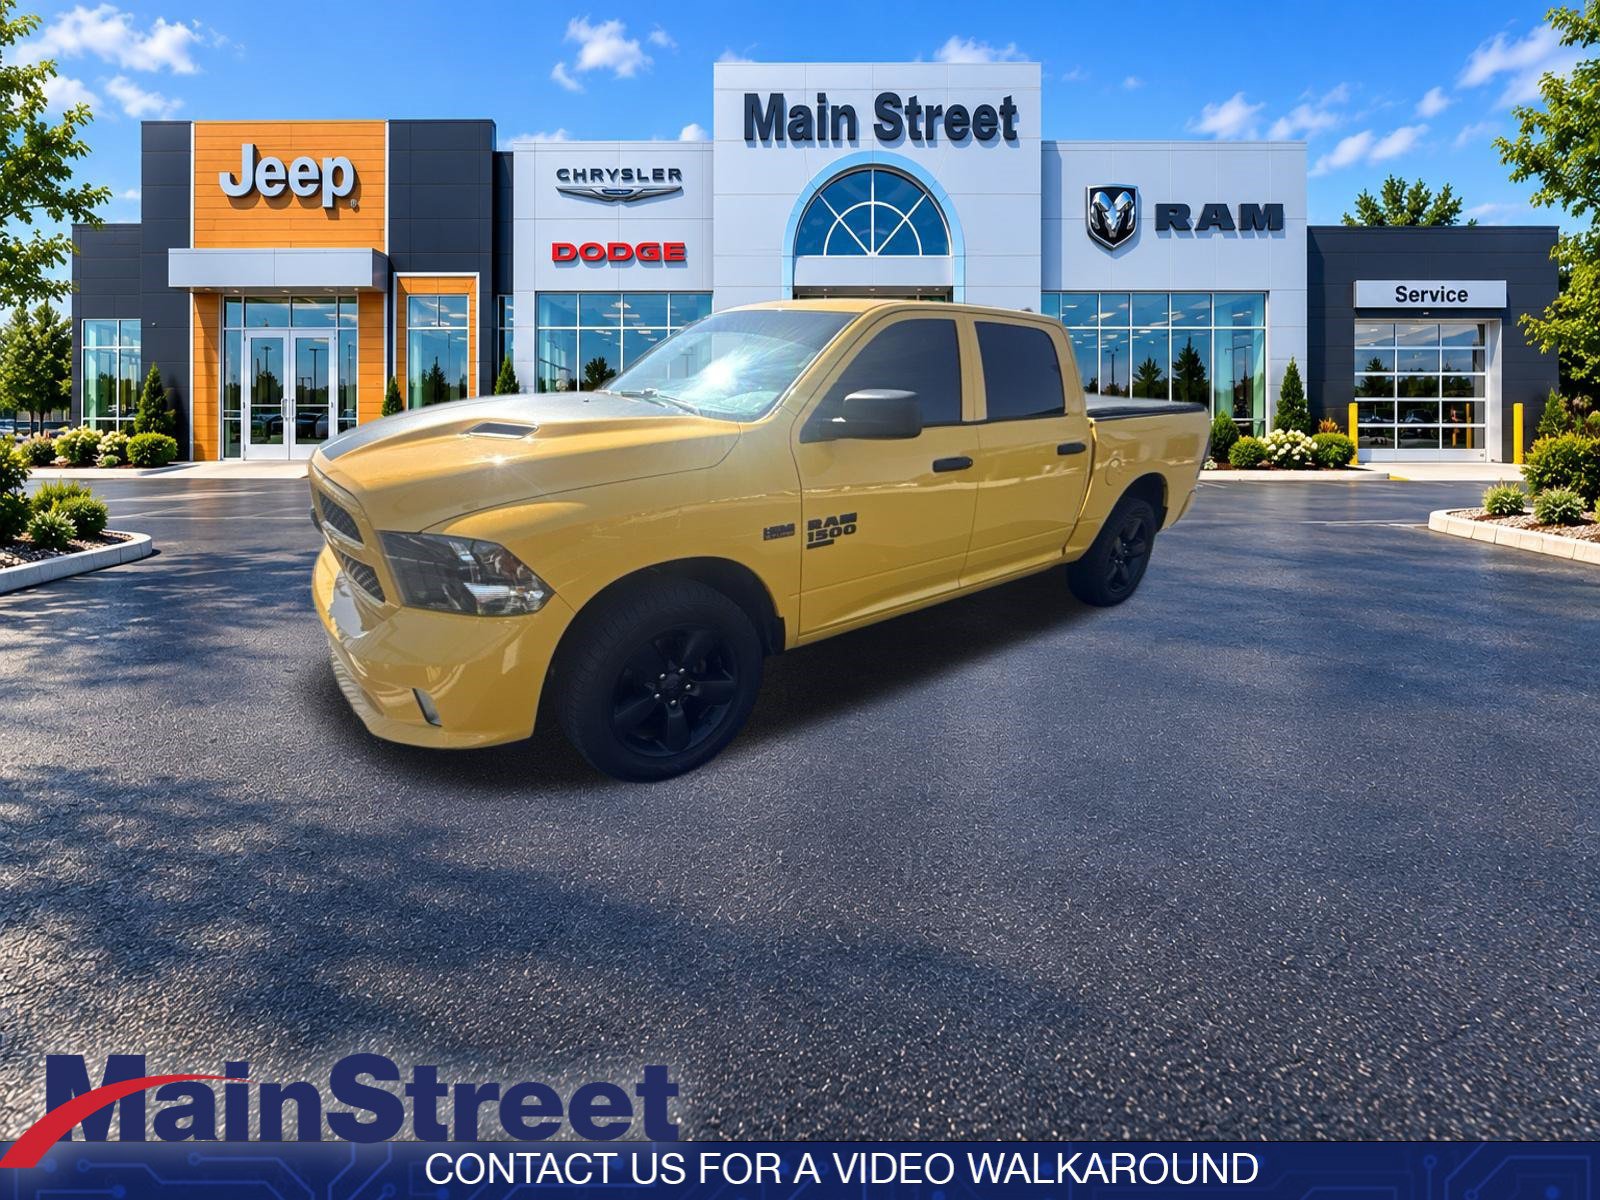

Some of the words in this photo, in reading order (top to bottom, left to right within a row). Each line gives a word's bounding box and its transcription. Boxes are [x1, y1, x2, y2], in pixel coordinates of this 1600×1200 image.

[744, 93, 856, 142] Main
[873, 92, 1017, 142] Street
[218, 143, 355, 208] Jeep
[556, 168, 682, 182] CHRYSLER
[1155, 203, 1284, 232] RAM
[551, 242, 686, 262] DODGE
[1395, 285, 1469, 303] Service
[807, 524, 857, 543] 1500
